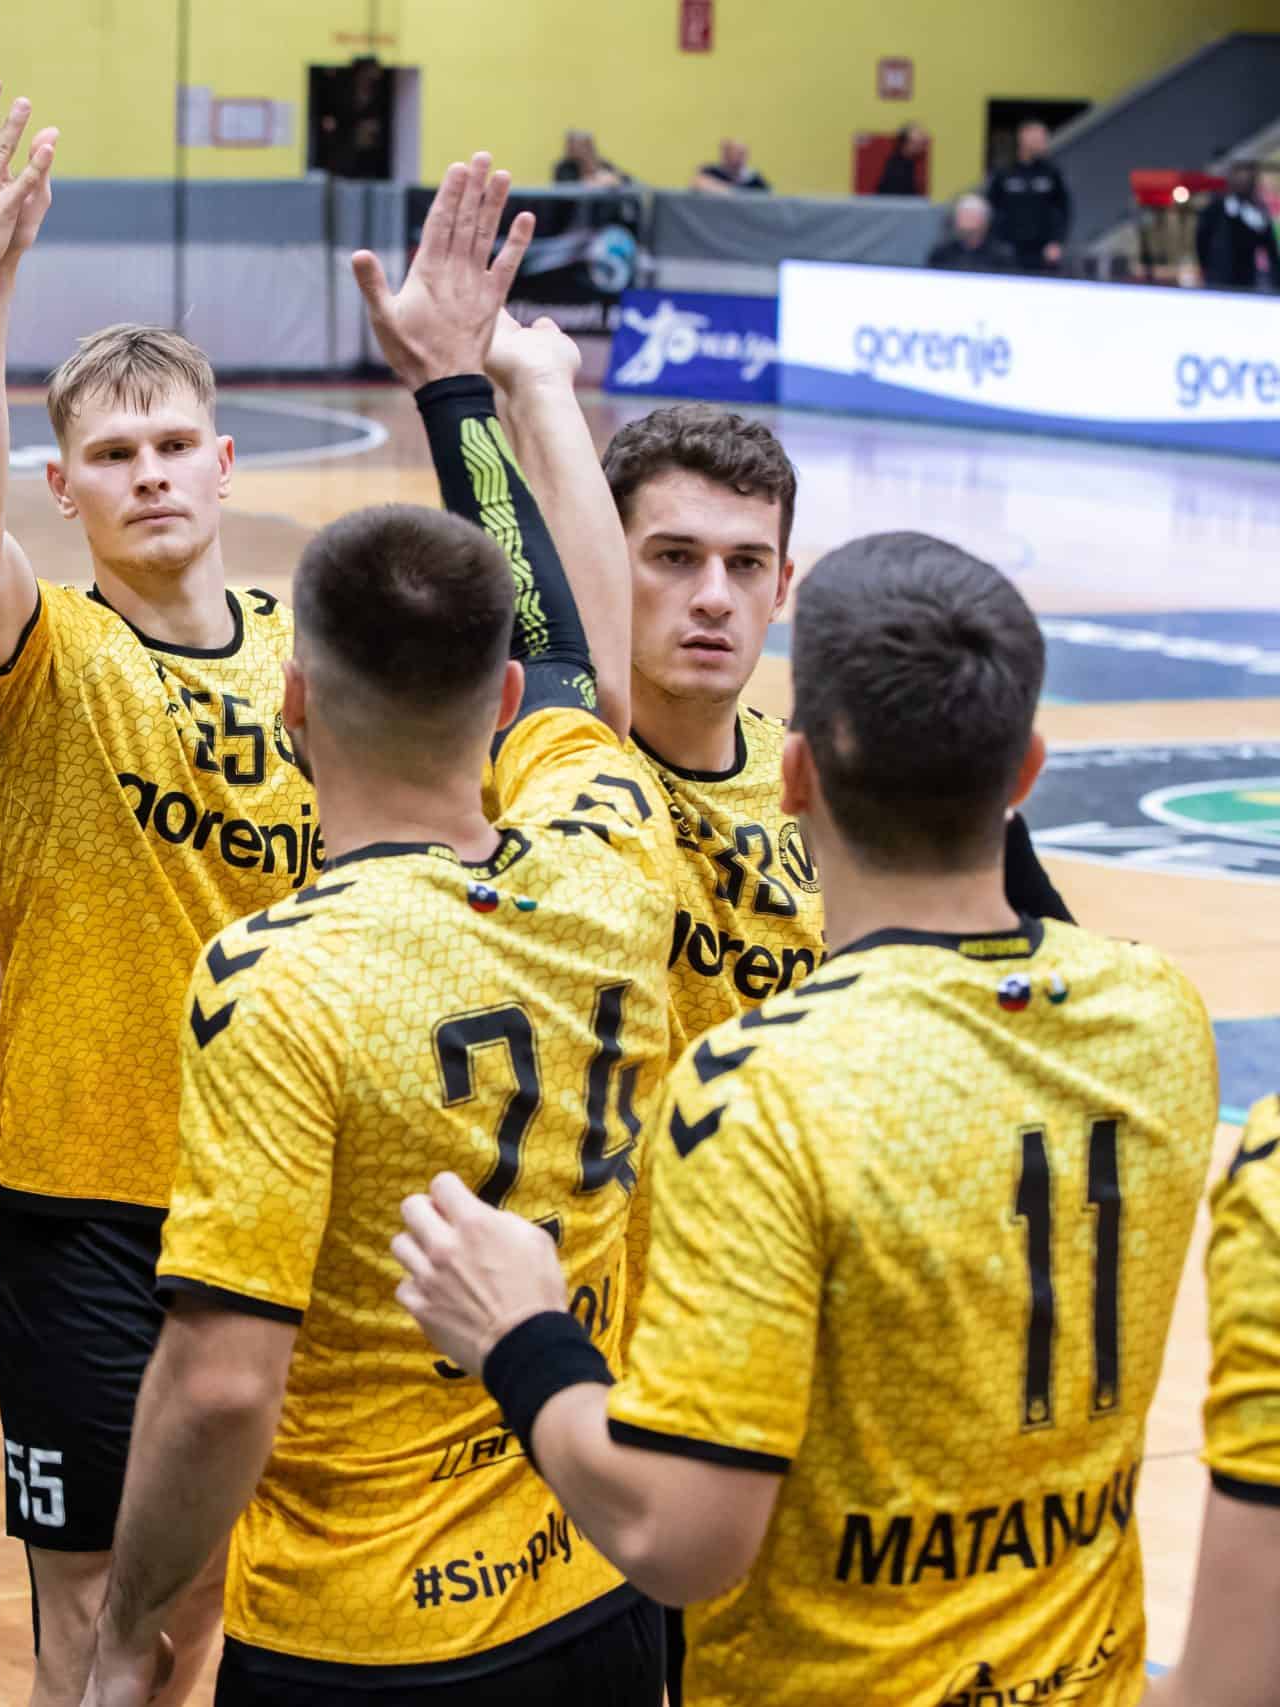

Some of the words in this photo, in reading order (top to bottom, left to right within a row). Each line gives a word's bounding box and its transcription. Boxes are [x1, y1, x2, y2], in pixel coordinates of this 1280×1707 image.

[853, 321, 1013, 385] gorenje
[181, 687, 266, 786] 55
[668, 909, 827, 1000] oren
[431, 978, 642, 1249] 24
[1010, 1111, 1127, 1433] 11
[4, 1439, 67, 1529] 55
